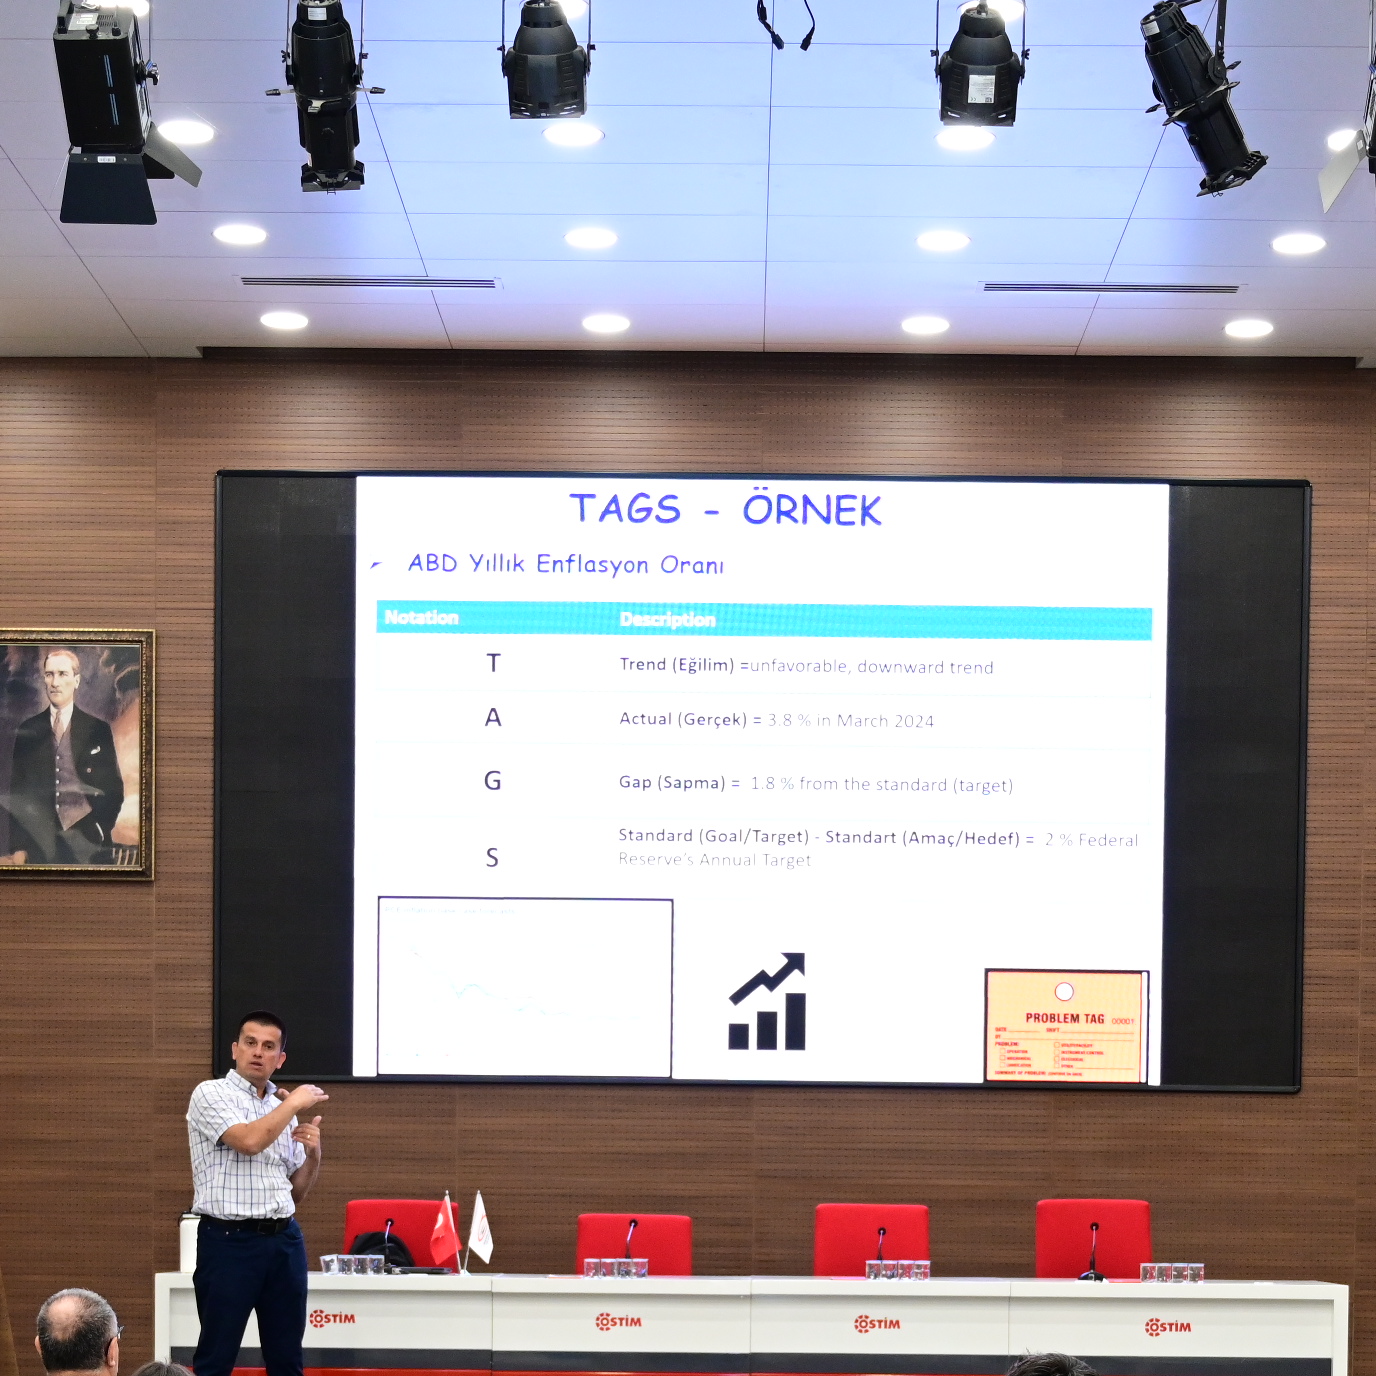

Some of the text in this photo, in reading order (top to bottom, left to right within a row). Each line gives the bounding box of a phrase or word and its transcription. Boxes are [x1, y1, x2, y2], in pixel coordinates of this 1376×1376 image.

[568, 492, 682, 524] TAGS
[743, 486, 883, 527] ÖRNEK
[407, 552, 724, 579] ABD Yıllık Enflasyon Oranı
[384, 610, 460, 626] Notation
[620, 611, 717, 630] Description
[486, 653, 502, 673] T
[619, 656, 667, 671] Trend
[672, 656, 734, 675] (Eğilim)
[857, 659, 944, 675] downward
[950, 660, 994, 675] trend
[484, 707, 502, 727] A
[619, 711, 672, 726] Actual
[677, 711, 747, 730] (Gerçek)
[768, 713, 792, 727] 3.8
[797, 713, 812, 727] %
[817, 713, 831, 727] in
[837, 713, 888, 728] March
[894, 714, 935, 729] 2024
[484, 770, 501, 791] G
[619, 774, 652, 792] Gap
[657, 774, 726, 793] (Sapma)
[751, 776, 775, 790] 1.8
[780, 776, 795, 790] %
[799, 776, 838, 791] from
[844, 776, 871, 791] the
[876, 777, 947, 792] standard
[953, 777, 1013, 796] (target)
[618, 827, 693, 842] Standard
[699, 827, 809, 847] (Goal/Target)
[825, 830, 897, 844] Standart
[902, 829, 1020, 849] (Amaç/Hedef)
[1045, 832, 1054, 846] 2
[1059, 833, 1073, 847] %
[1079, 833, 1138, 847] Federal
[486, 847, 499, 868] S
[699, 853, 756, 867] Annual
[762, 853, 812, 871] Target
[1025, 1012, 1105, 1025] PROBLEM TAG
[1111, 1017, 1135, 1025] 00001
[312, 1310, 356, 1325] OSTİM
[599, 1314, 642, 1328] OSTİM
[858, 1316, 900, 1330] OSTİM
[1149, 1319, 1192, 1333] OSTİM
